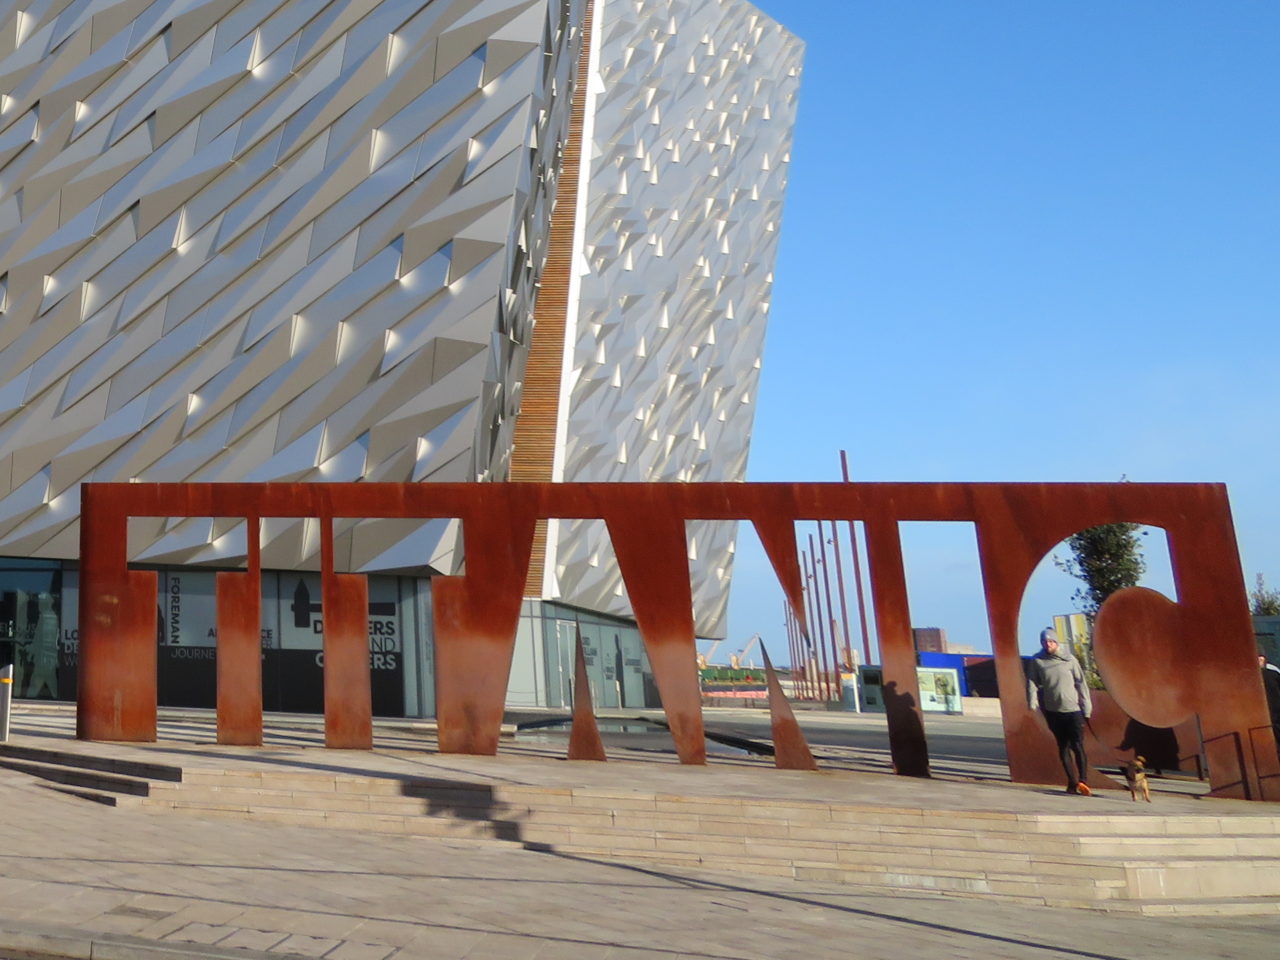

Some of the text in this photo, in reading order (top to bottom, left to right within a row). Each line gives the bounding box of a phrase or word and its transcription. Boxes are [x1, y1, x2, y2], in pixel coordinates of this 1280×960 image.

[170, 576, 181, 644] FOREMAN
[371, 637, 396, 652] ND
[170, 647, 216, 660] JOURNE
